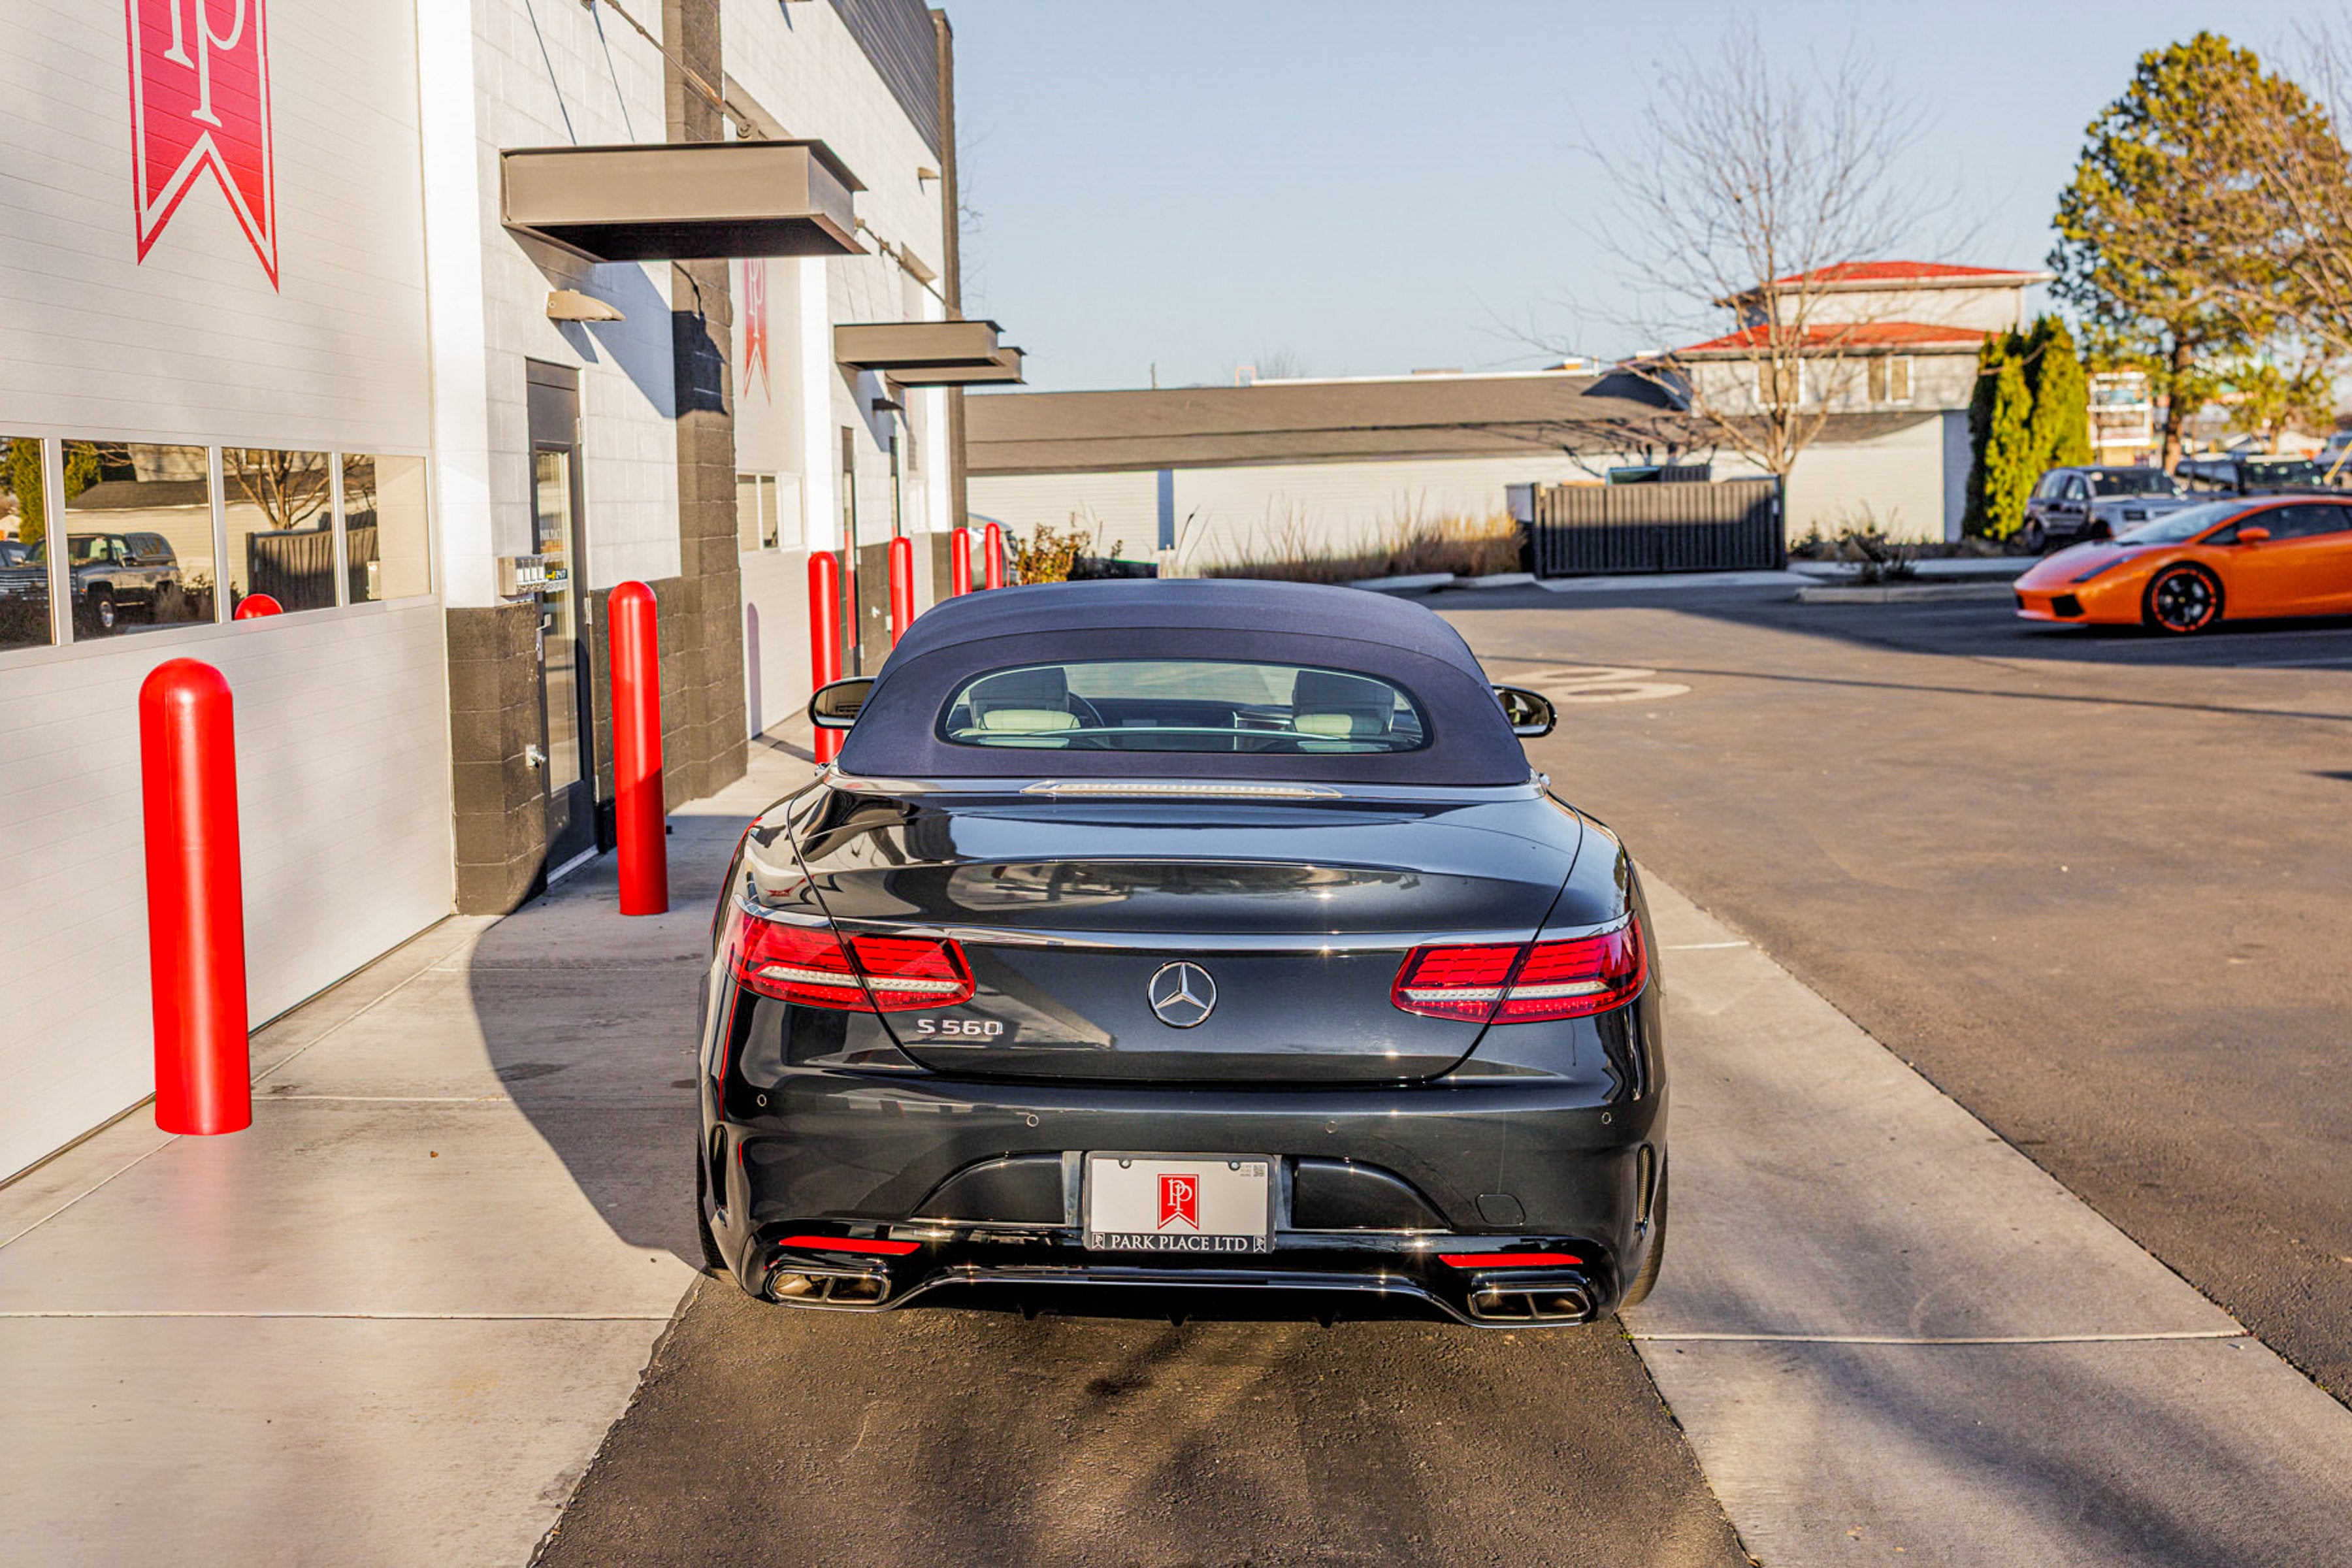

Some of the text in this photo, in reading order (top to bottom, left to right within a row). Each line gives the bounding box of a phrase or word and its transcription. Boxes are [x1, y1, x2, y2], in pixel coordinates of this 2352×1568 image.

[917, 1019, 1004, 1036] S 560
[1111, 1235, 1156, 1249] PARK
[1158, 1235, 1209, 1250] PLACE
[1214, 1236, 1248, 1251] LTD
